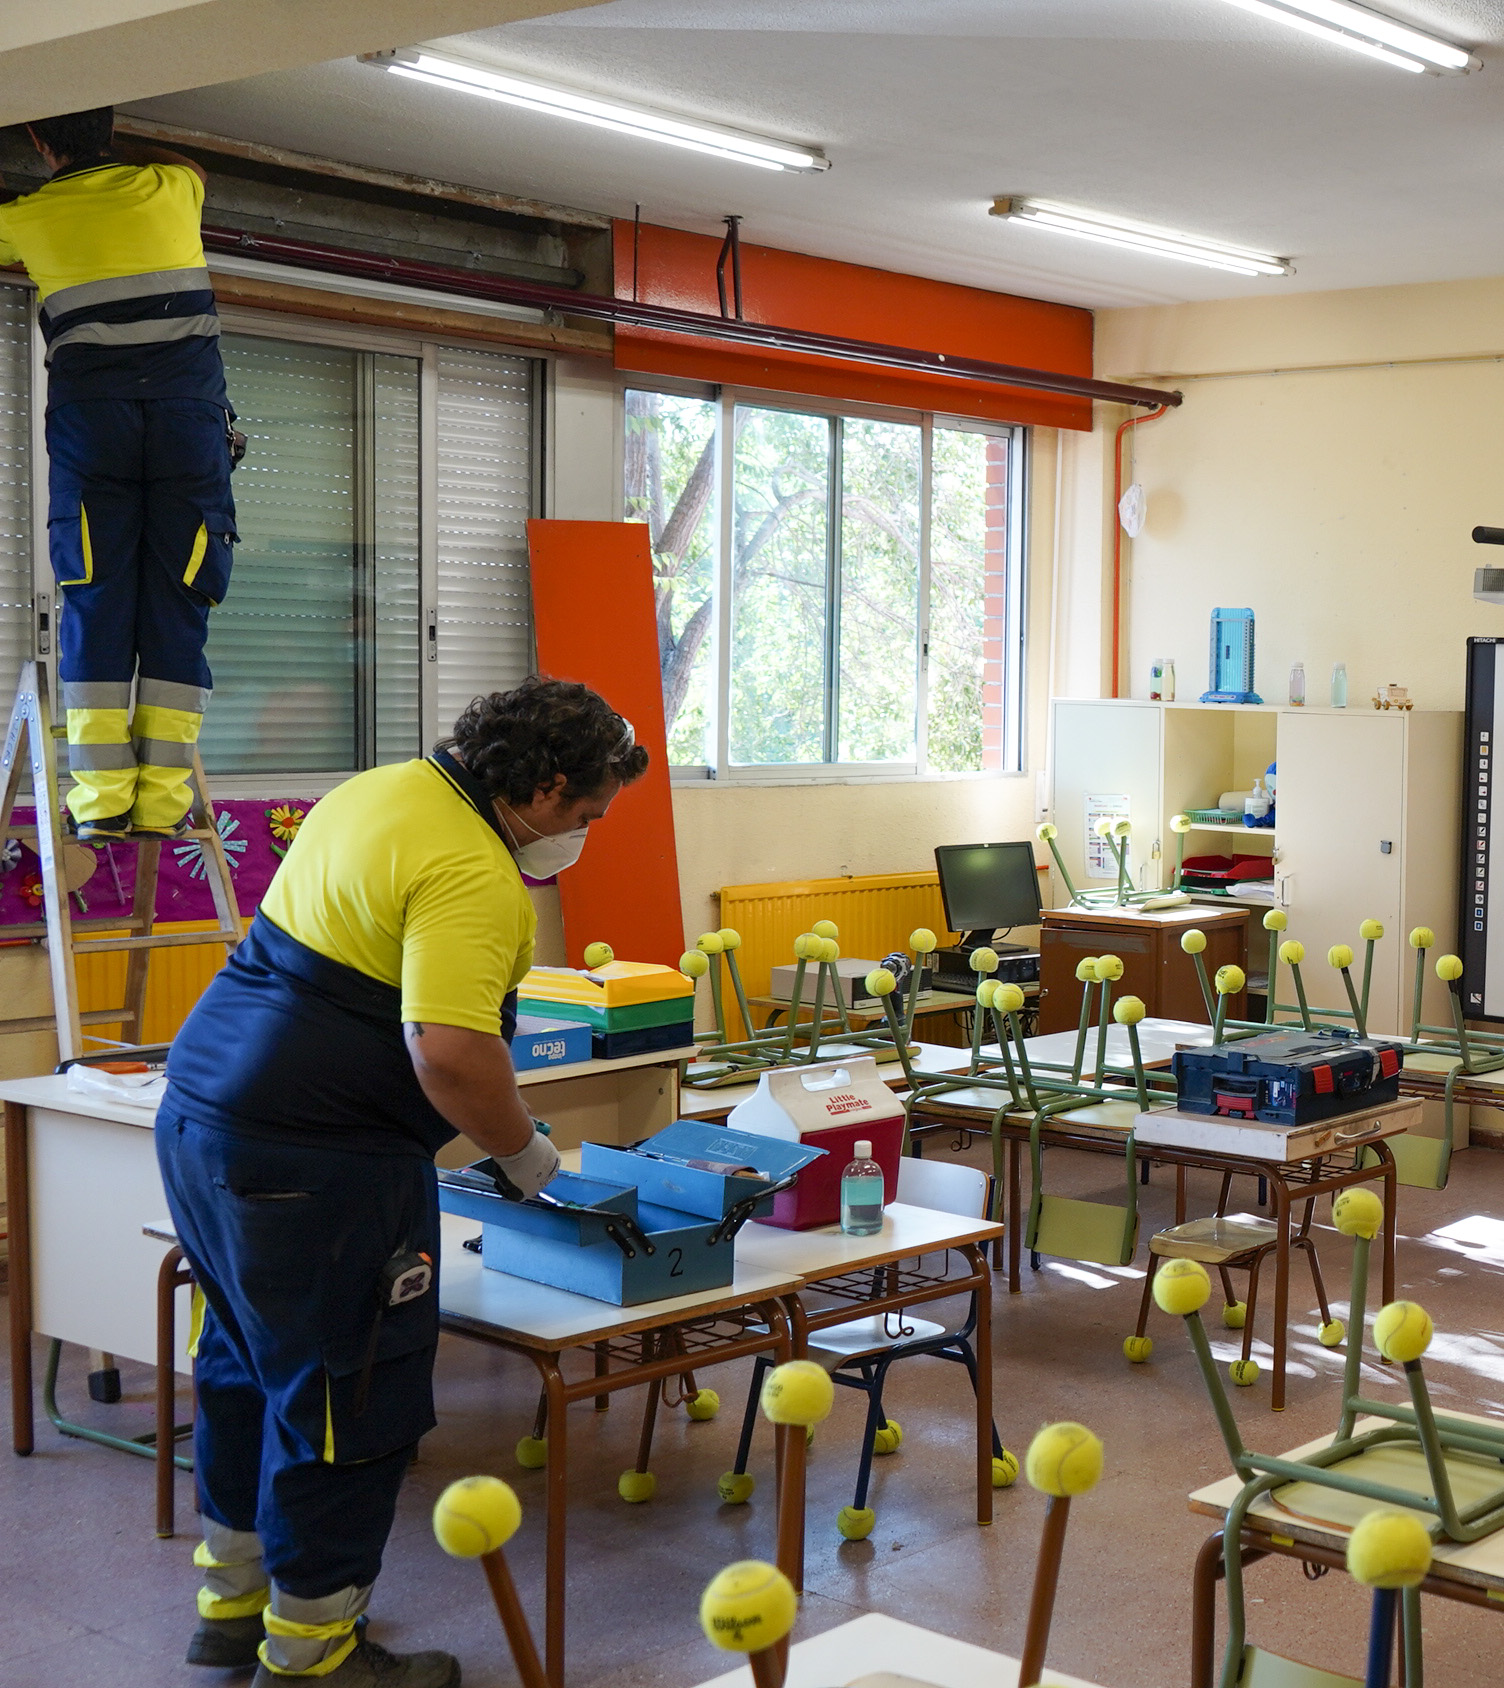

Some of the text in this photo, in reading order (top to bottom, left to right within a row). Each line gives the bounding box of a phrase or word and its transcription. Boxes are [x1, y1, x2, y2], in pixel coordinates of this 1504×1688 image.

[532, 1040, 566, 1058] tecno
[826, 1099, 870, 1111] Playmate
[829, 1094, 856, 1104] Little
[668, 1248, 683, 1277] 2
[712, 1615, 762, 1631] Wilson
